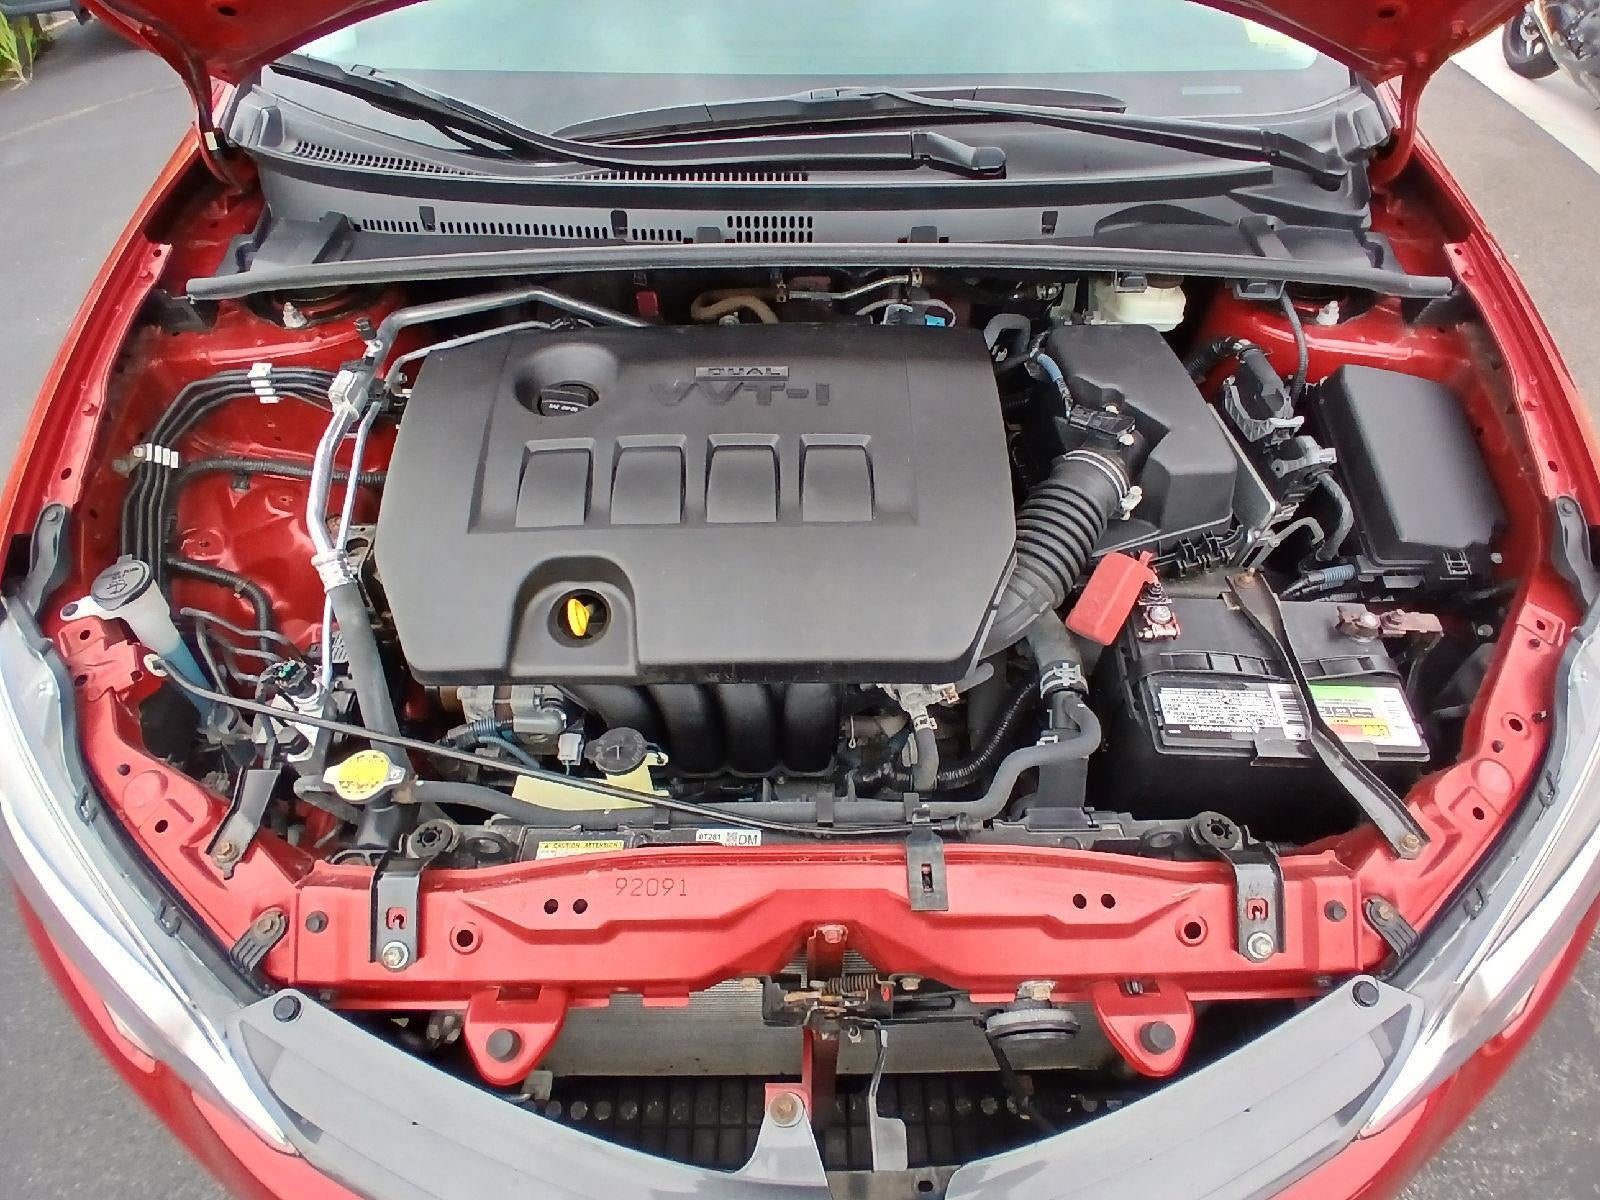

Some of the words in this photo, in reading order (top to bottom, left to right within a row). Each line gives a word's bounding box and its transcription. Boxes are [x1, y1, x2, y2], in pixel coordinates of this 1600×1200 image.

[708, 367, 781, 376] DUAL
[738, 834, 758, 845] DM
[615, 877, 687, 897] 92091
